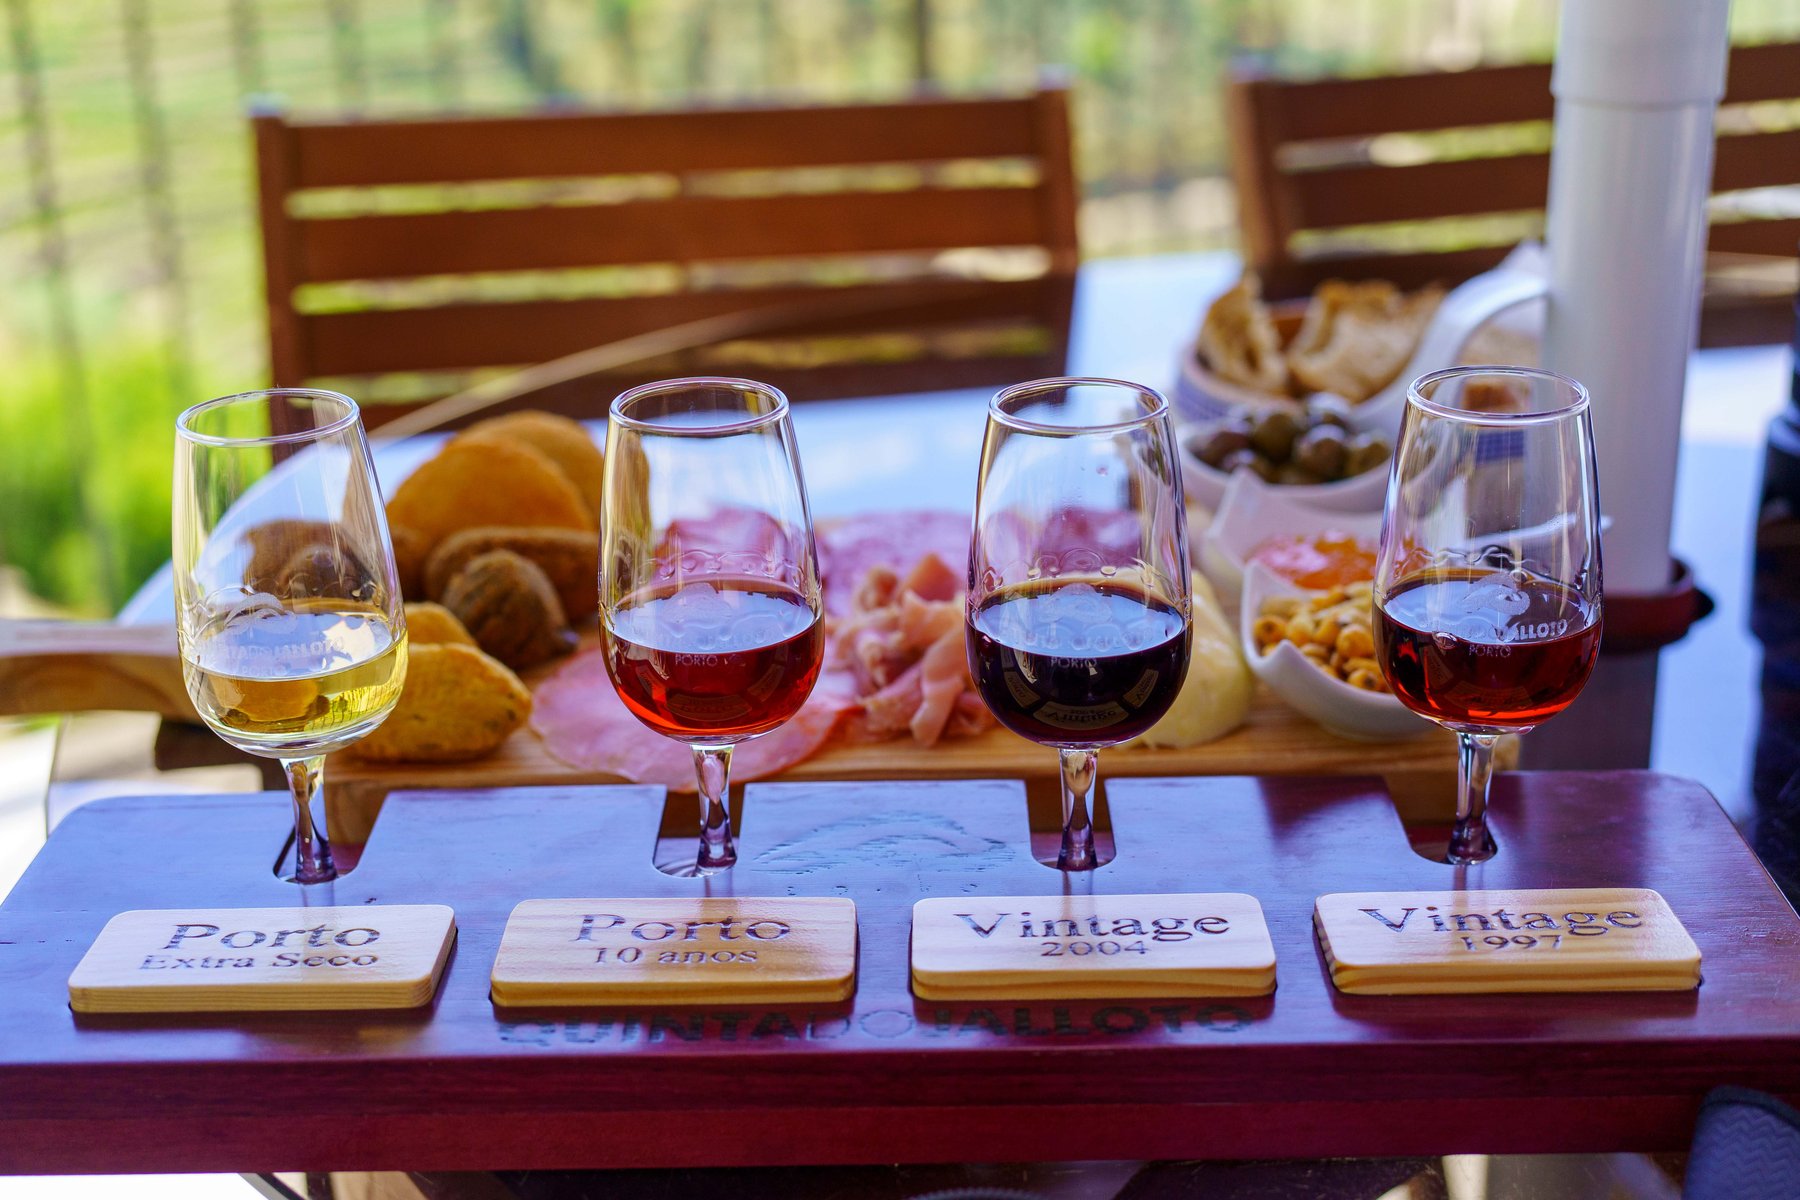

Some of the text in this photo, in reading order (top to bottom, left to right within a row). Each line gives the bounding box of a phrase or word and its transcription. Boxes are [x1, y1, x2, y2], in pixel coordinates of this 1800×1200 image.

[1468, 643, 1512, 658] PORTO
[674, 653, 718, 668] PORTO
[1050, 656, 1098, 670] PORTO
[569, 913, 791, 942] Porto
[953, 911, 1229, 942] Vintage
[1358, 905, 1642, 937] Vintage
[161, 923, 380, 950] Porto
[1460, 934, 1562, 951] 1997
[595, 946, 758, 964] 10 anos
[1040, 940, 1151, 957] 2004
[139, 952, 379, 970] Extra Seco
